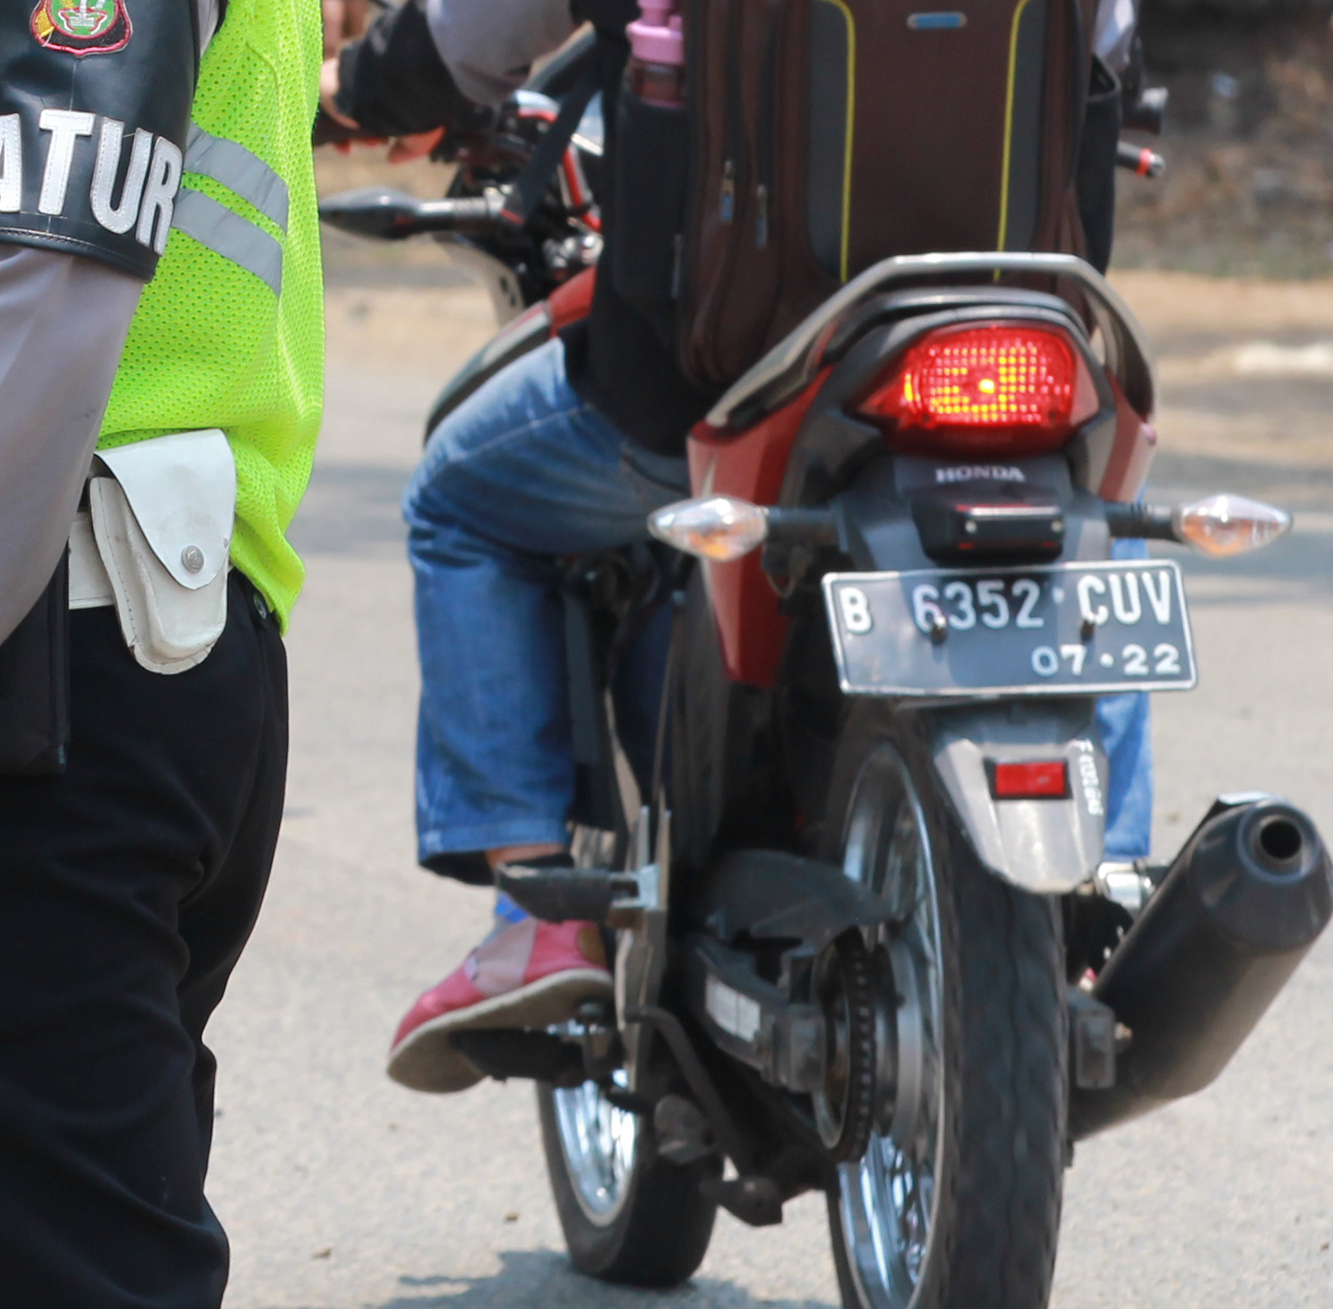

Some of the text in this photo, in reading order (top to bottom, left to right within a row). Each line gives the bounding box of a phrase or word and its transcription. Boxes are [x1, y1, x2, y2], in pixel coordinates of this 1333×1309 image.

[935, 465, 1027, 484] HONDA
[839, 569, 1172, 635] B 6352 CUV
